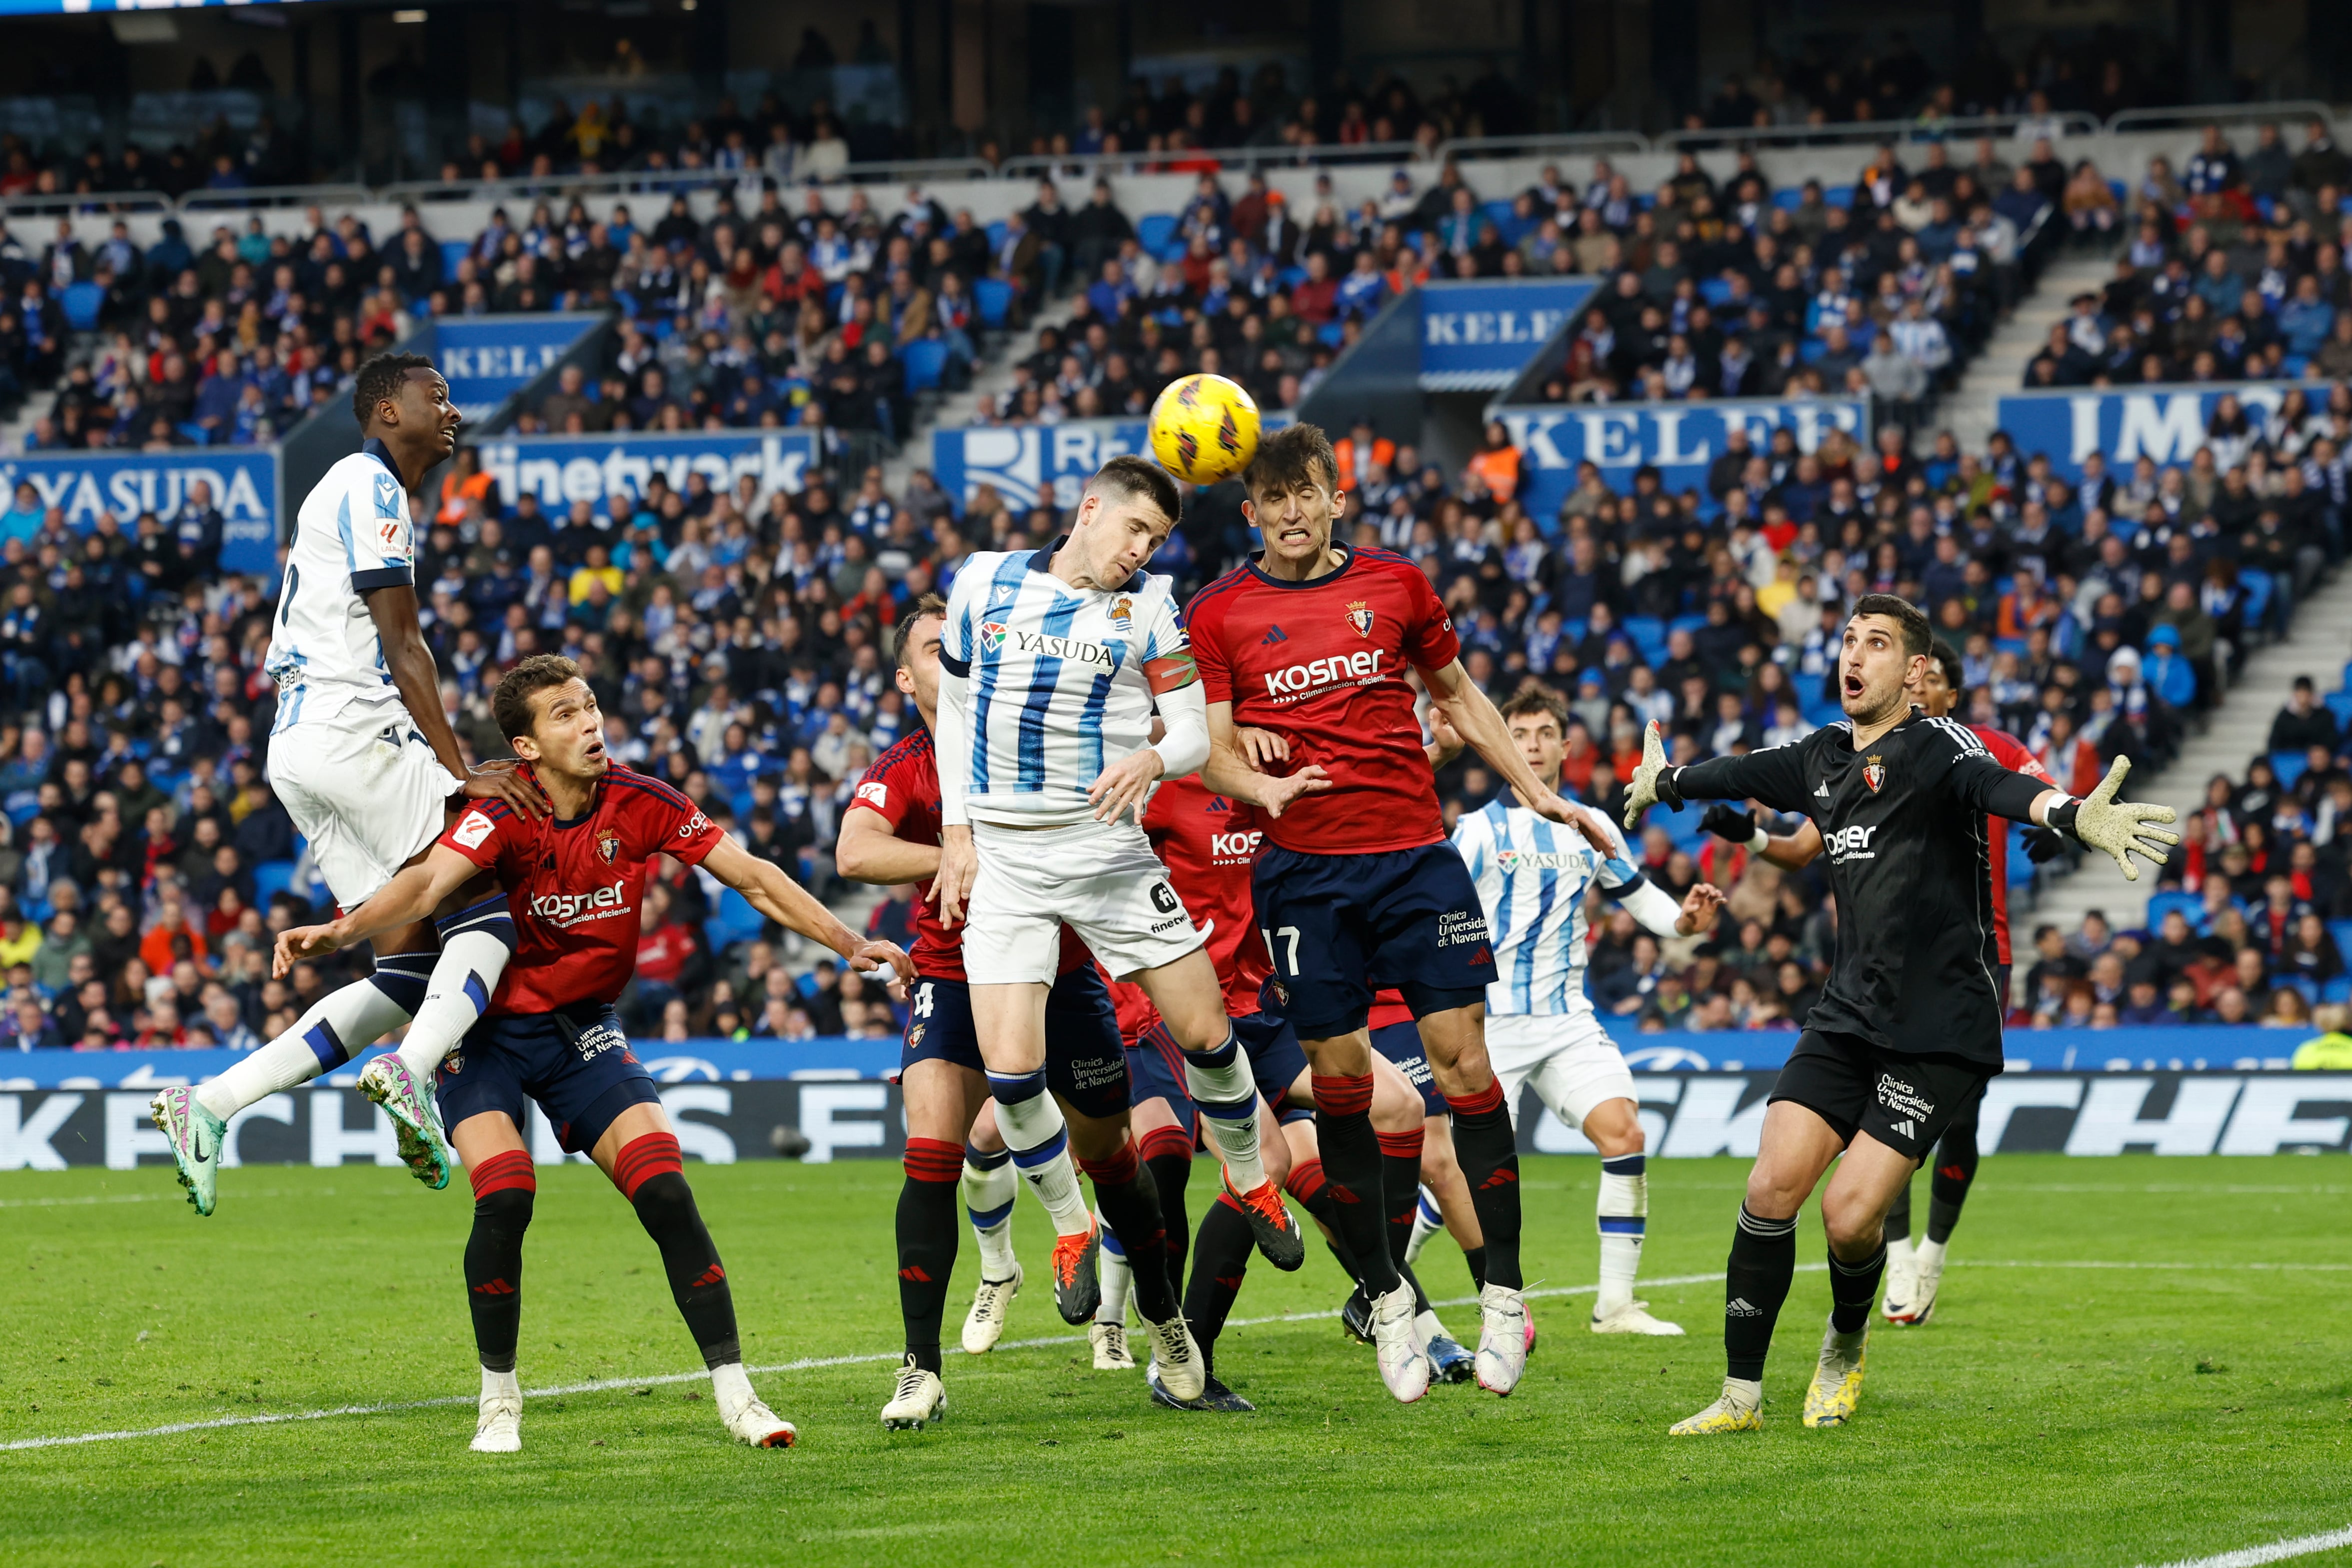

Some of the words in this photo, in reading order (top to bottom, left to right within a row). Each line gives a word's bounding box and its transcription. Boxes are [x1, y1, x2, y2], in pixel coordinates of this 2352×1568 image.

[29, 467, 269, 523] YASUDA
[1016, 631, 1113, 666] YASUDA
[1092, 665, 1113, 676] group
[1300, 681, 1355, 700] Climatización
[457, 833, 475, 846] LALIGA
[1522, 854, 1589, 869] YASUDA
[597, 907, 631, 919] eficiente
[1438, 937, 1448, 947] de
[1451, 931, 1489, 945] Navarra
[1262, 926, 1300, 977] 17
[914, 982, 935, 1018] 4
[578, 1029, 626, 1052] Universidad
[583, 1050, 596, 1061] de
[596, 1039, 628, 1053] Navarra
[1071, 1057, 1103, 1069] Clínica
[1073, 1056, 1124, 1080] Universidad
[1075, 1080, 1087, 1090] de
[1089, 1070, 1123, 1087] Navarra
[1882, 1073, 1914, 1095] Clínica
[1877, 1082, 1935, 1115] Universidad
[1887, 1097, 1927, 1123] Navarra
